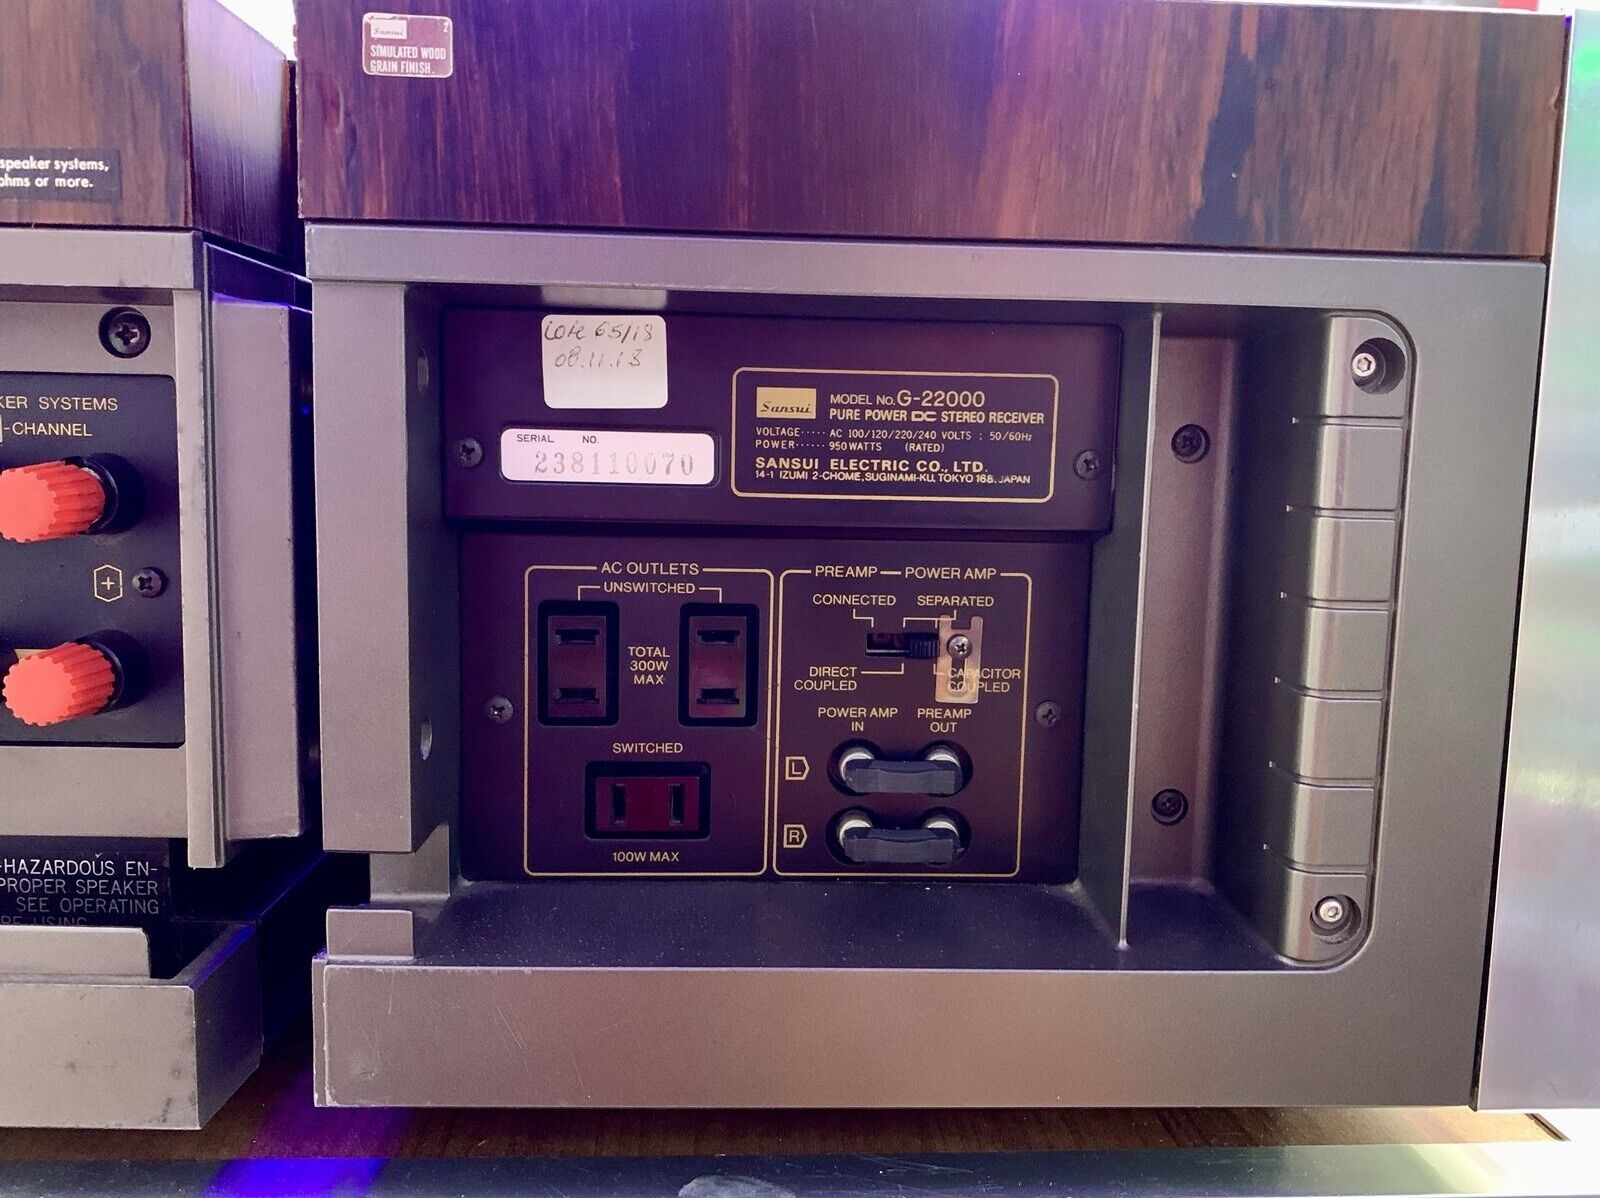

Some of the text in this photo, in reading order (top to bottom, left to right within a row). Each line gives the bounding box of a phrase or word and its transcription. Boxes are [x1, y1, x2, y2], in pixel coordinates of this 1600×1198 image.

[370, 45, 447, 60] SIMULATED WOOD
[370, 60, 398, 73] GRAIN
[0, 155, 109, 173] speaker systems,
[34, 177, 49, 188] or
[54, 177, 94, 188] more.
[39, 396, 118, 411] SYSTEMS
[830, 393, 873, 405] MODEL
[897, 389, 986, 407] G-22000
[760, 401, 812, 414] Sansui
[829, 408, 1045, 424] PURE POWER DC STEREO RECEIVER
[516, 434, 599, 444] SERIAL NO.
[829, 429, 843, 438] AC
[848, 429, 937, 440] 100/120/220/240
[941, 431, 972, 441] VOLTS
[989, 431, 1033, 442] 50/60Hz
[904, 442, 945, 453] (RATED)
[534, 451, 694, 476] 238110070
[755, 457, 988, 473] SANSUI ELECTRIC CO., LTD.
[779, 470, 808, 480] IZUMI
[938, 473, 974, 483] TOKYO
[998, 475, 1031, 484] JAPAN
[601, 562, 700, 576] AC OUTLETS
[815, 566, 997, 580] PREAMP POWER AMP
[603, 582, 696, 594] UNSWITCHED
[812, 594, 994, 608] CONNECTED SEPARATED
[628, 646, 670, 658] TOTAL
[629, 661, 669, 671] 300W
[809, 666, 858, 678] DIRECT
[633, 675, 664, 685] MAX
[794, 680, 857, 692] COUPLED
[818, 707, 899, 719] POWER AMP
[917, 708, 973, 720] PREAMP
[851, 722, 864, 732] IN
[930, 722, 958, 733] OUT
[612, 742, 684, 754] SWITCHED
[612, 851, 680, 862] 100W MAX
[125, 861, 158, 876] EN-
[75, 879, 159, 896] SPEAKER
[15, 896, 160, 914] SEE OPERATING
